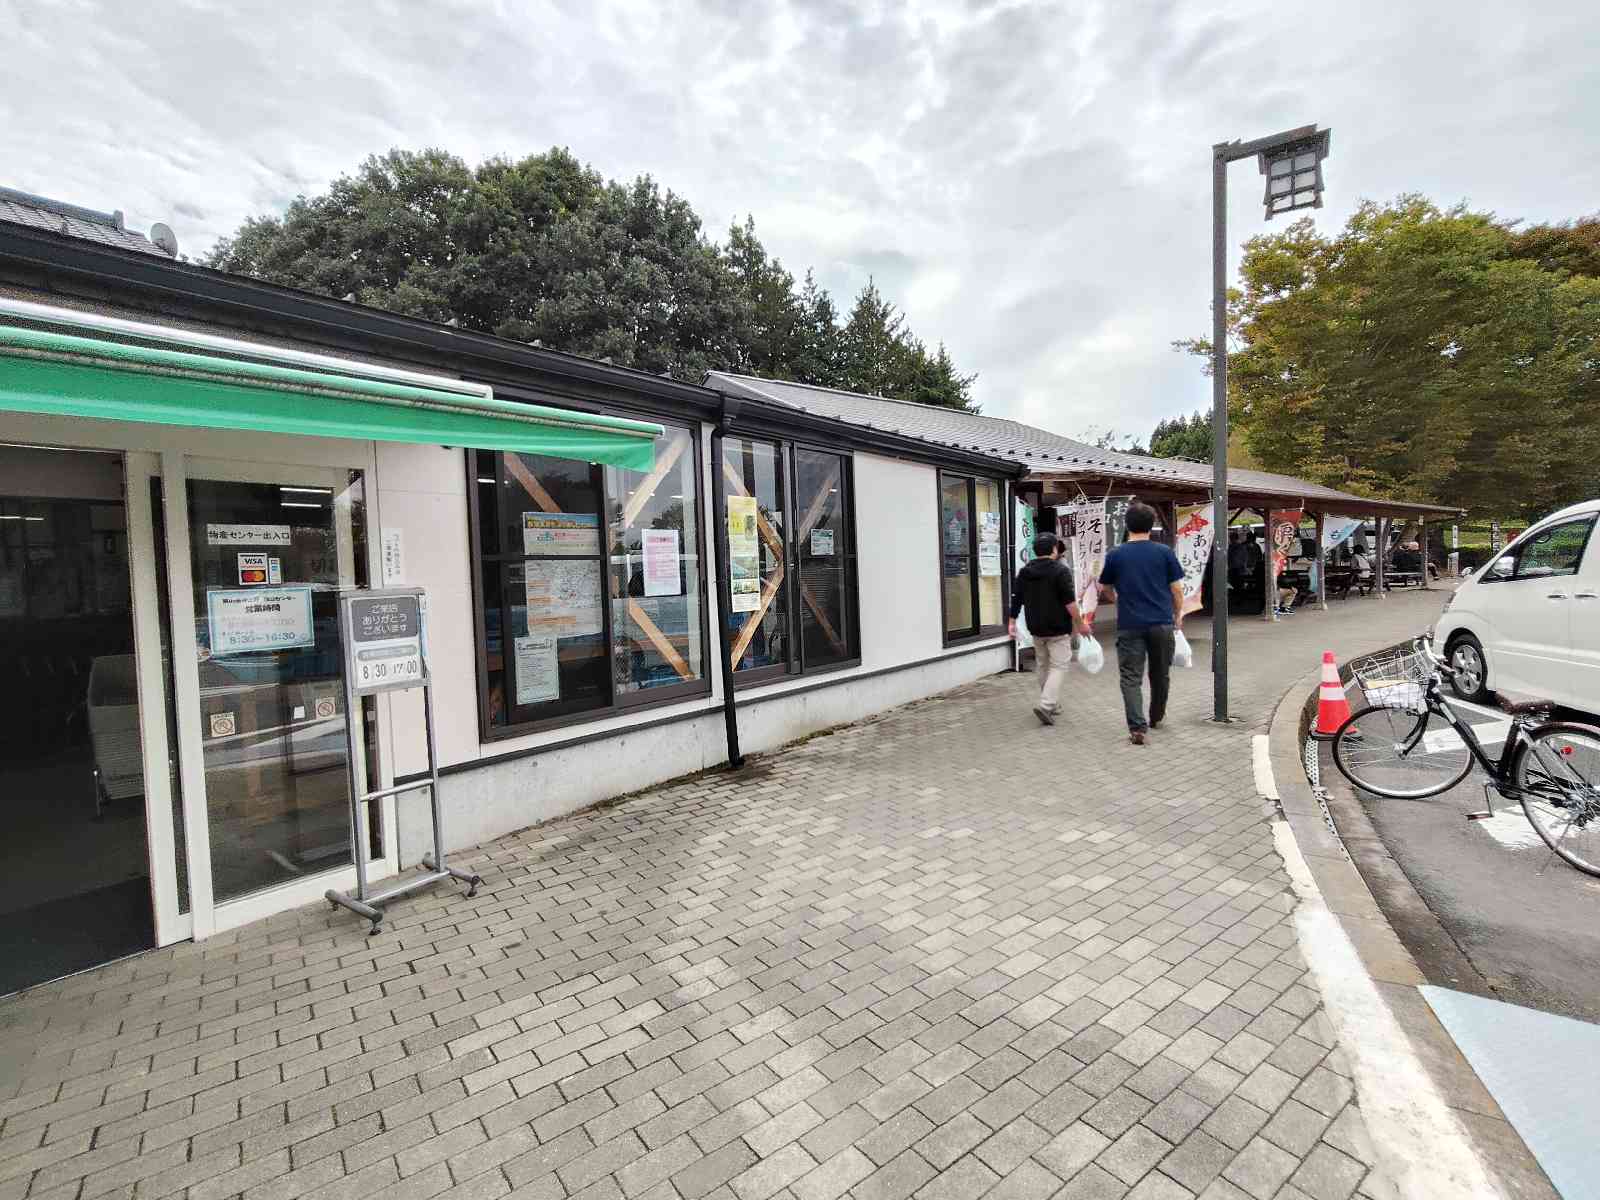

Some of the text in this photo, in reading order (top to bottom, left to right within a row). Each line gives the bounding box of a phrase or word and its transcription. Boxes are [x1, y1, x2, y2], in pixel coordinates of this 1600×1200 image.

[362, 614, 408, 625] ありがとう
[362, 624, 408, 636] ございます
